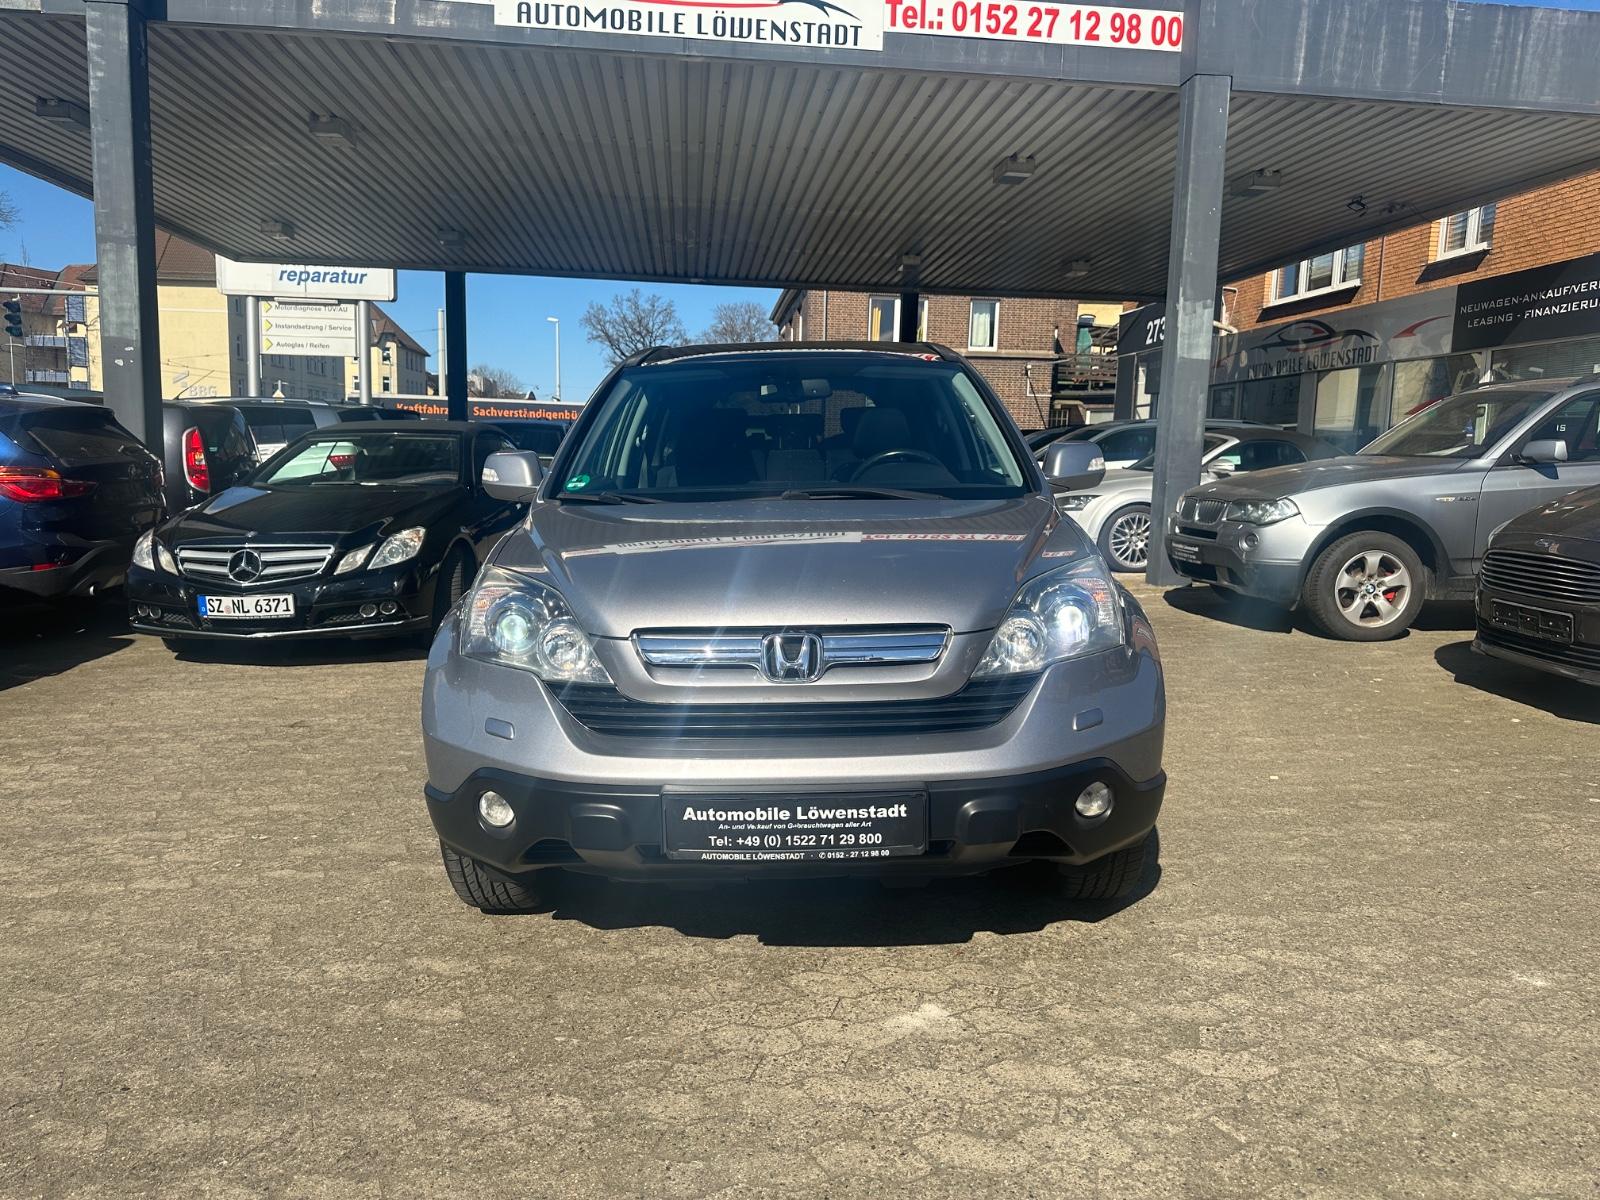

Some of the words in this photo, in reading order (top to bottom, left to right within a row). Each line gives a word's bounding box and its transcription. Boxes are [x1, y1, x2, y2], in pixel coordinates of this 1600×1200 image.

[517, 1, 686, 35] AUTOMOBILE
[697, 10, 863, 47] LÖWENSTADT
[885, 0, 944, 30] Tel.:
[952, 1, 1018, 35] 0152
[1027, 6, 1060, 38] 27
[1069, 10, 1101, 41] 12
[1110, 12, 1141, 43] 98
[1151, 15, 1182, 47] 00
[278, 269, 368, 286] reparatur
[1460, 280, 1600, 315] NEUWAGEN-ANKAUF/VER
[1467, 313, 1513, 328] LEASING
[1524, 298, 1600, 319] FINANZIERU
[275, 323, 323, 331] Instandsetzung
[276, 341, 304, 349] Autoglas
[473, 406, 579, 420] Sachverständigenbü
[208, 598, 224, 613] SZ
[231, 598, 250, 613] NL
[254, 598, 291, 613] 6371
[683, 807, 791, 821] Automobile
[796, 804, 907, 820] Löwenstadt
[708, 836, 732, 847] Tel:
[736, 835, 760, 847] +49
[764, 834, 781, 848] (0)
[785, 835, 817, 846] 1522
[820, 834, 834, 845] 71
[839, 834, 855, 845] 29
[859, 833, 882, 844] 800
[701, 852, 751, 860] AUTOMOBILE
[752, 851, 805, 860] LÖWENSTADT
